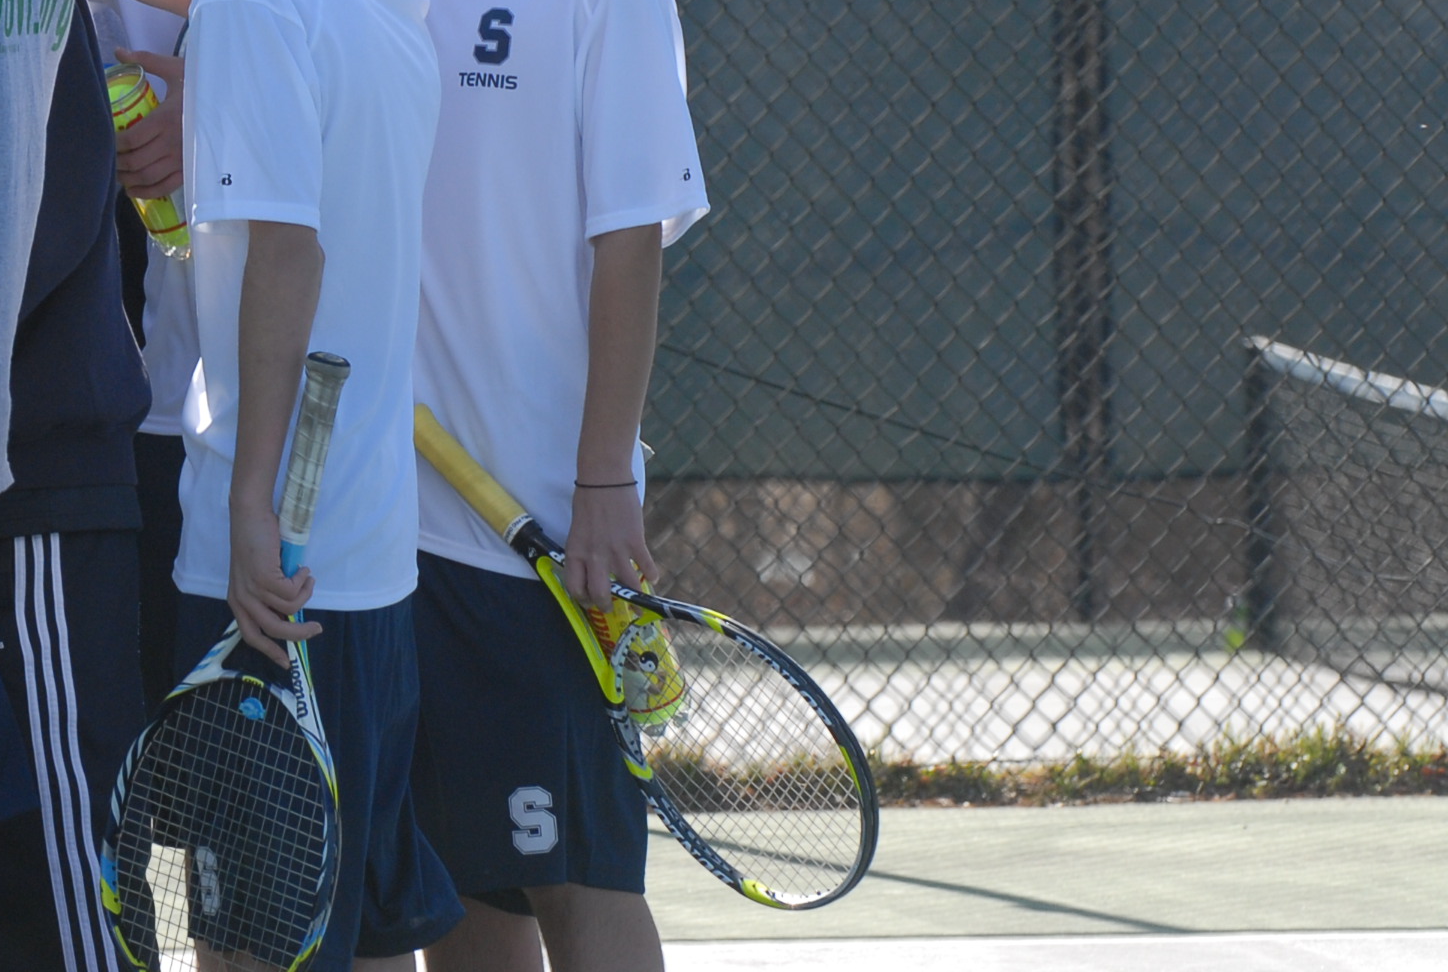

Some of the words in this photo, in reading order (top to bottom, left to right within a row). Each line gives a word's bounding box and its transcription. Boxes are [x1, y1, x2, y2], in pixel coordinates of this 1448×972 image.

[473, 7, 515, 66] S
[458, 71, 519, 91] TENNIS
[290, 655, 309, 720] Wilson
[508, 786, 559, 856] S
